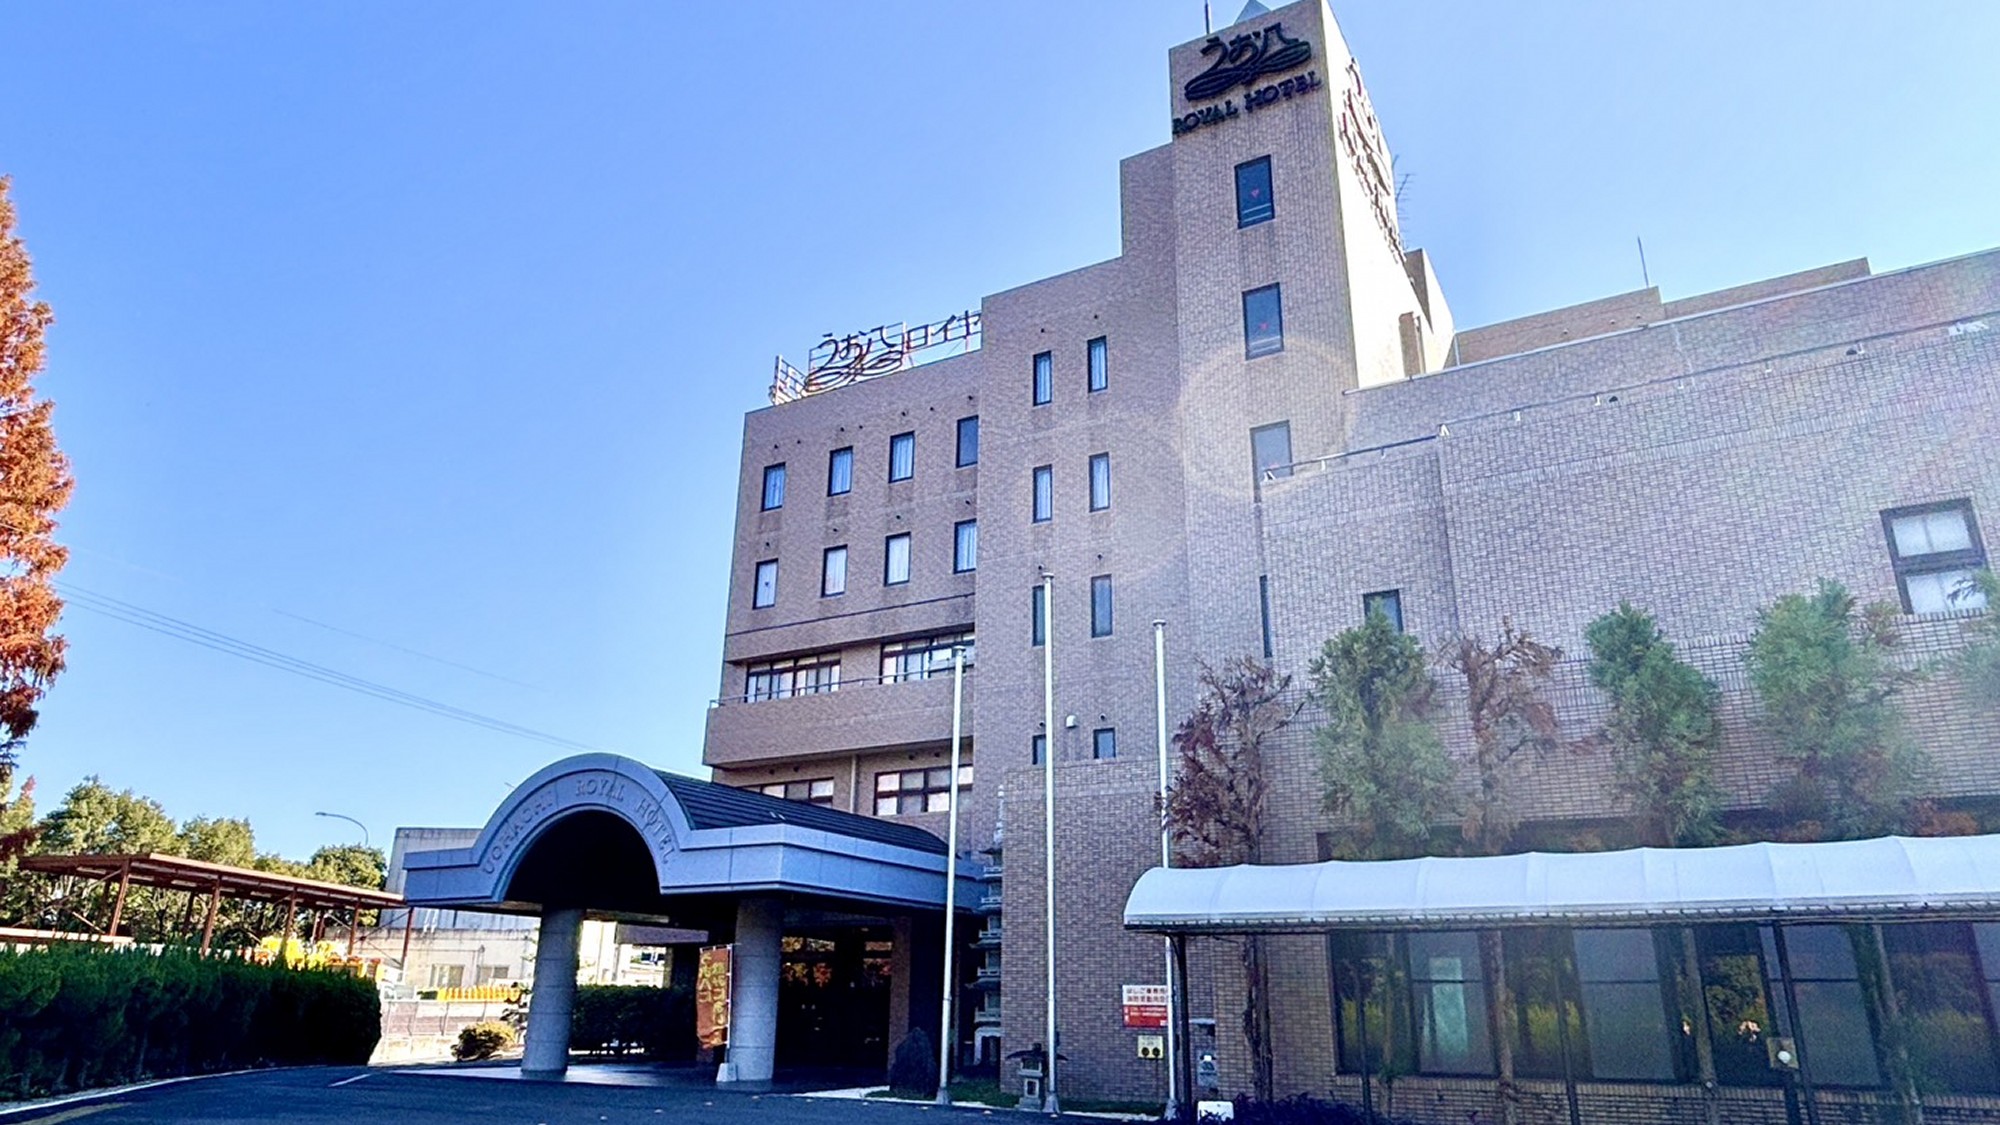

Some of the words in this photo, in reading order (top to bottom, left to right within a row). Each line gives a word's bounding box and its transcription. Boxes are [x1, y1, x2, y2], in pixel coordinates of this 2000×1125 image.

[1172, 99, 1239, 136] ROYAL
[1243, 70, 1322, 113] HOTEL
[482, 791, 556, 875] UOHACHI
[575, 778, 626, 803] ROYAL
[636, 797, 676, 865] HOTEL
